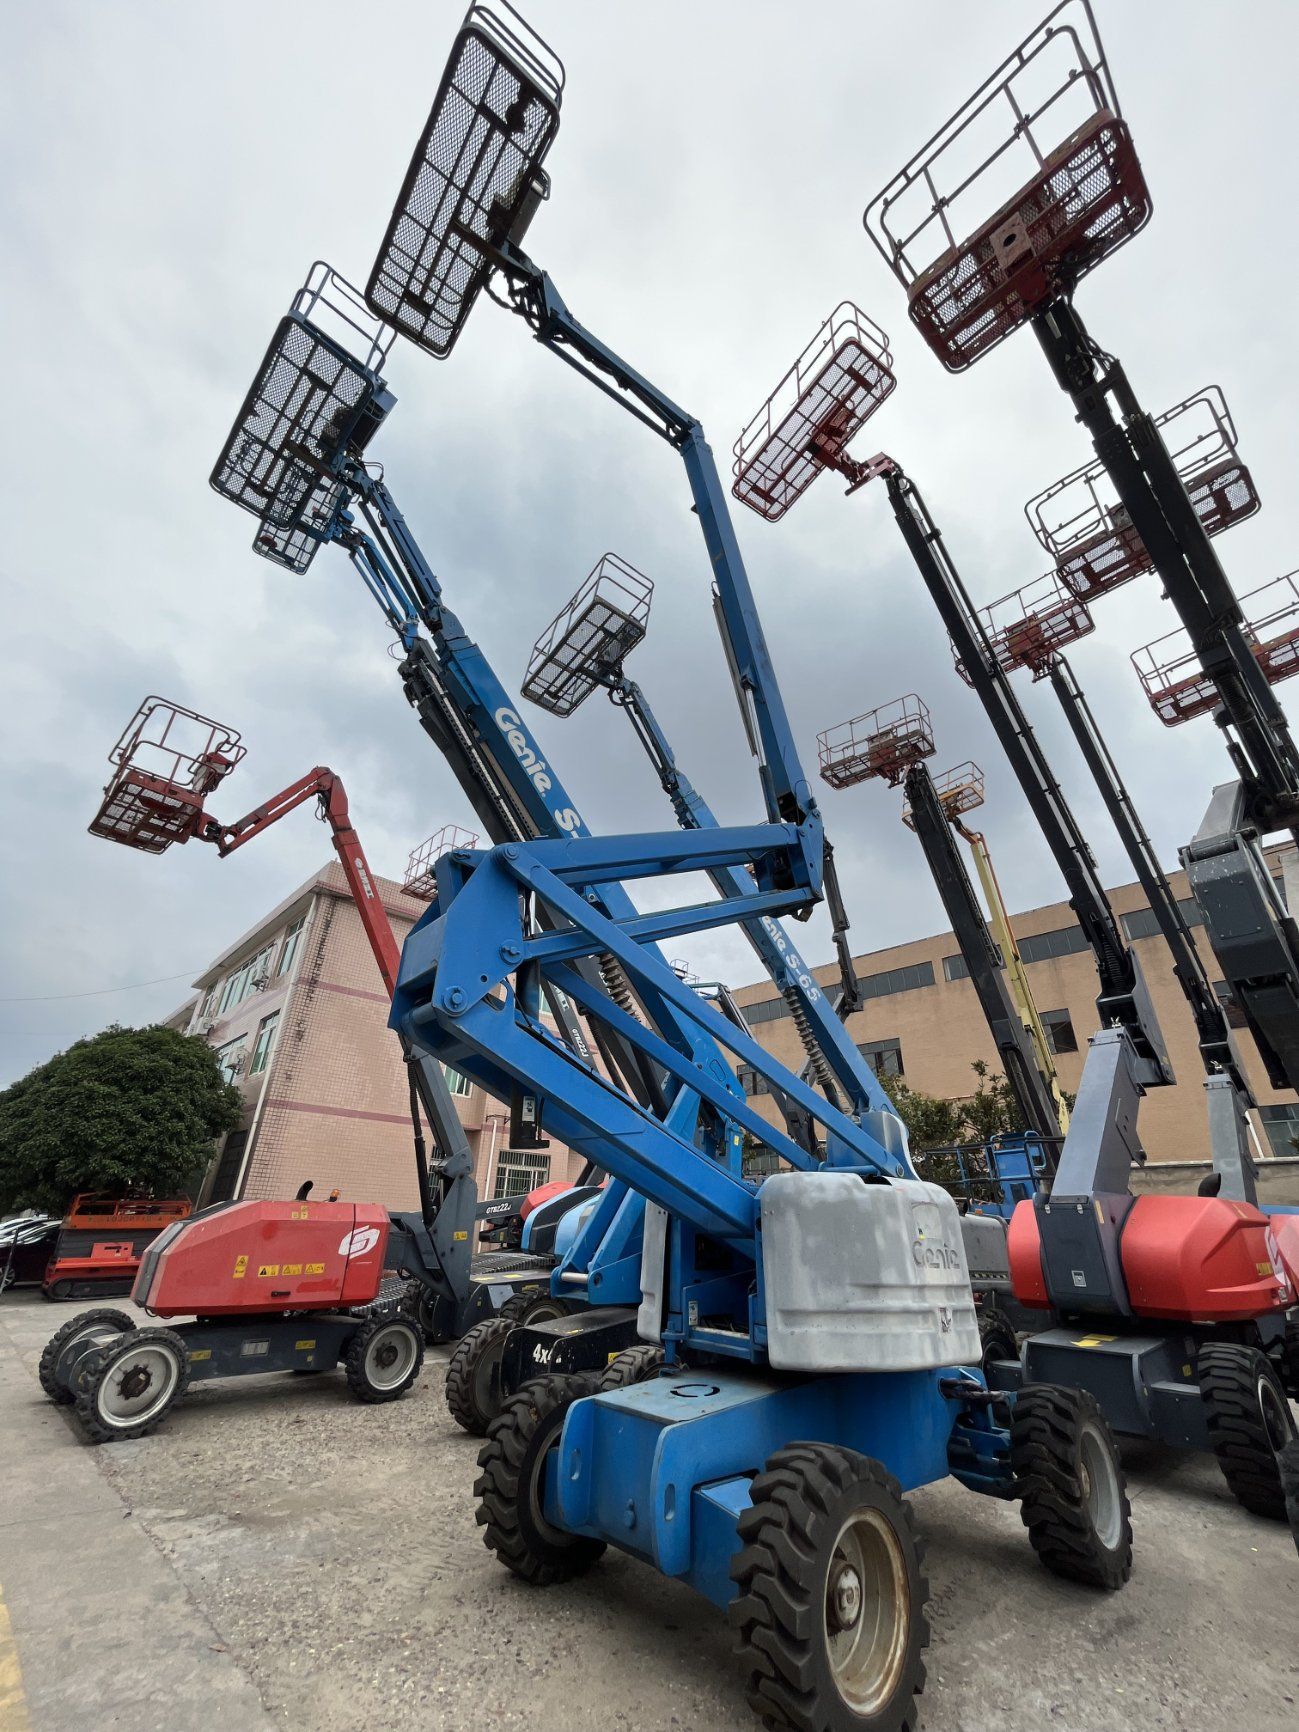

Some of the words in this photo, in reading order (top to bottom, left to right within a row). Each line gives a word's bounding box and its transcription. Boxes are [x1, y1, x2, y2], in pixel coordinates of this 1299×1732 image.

[494, 707, 552, 797] Genie
[554, 808, 581, 838] S-
[762, 916, 786, 953] enie
[786, 954, 821, 1001] S-65
[912, 1240, 960, 1269] Genie
